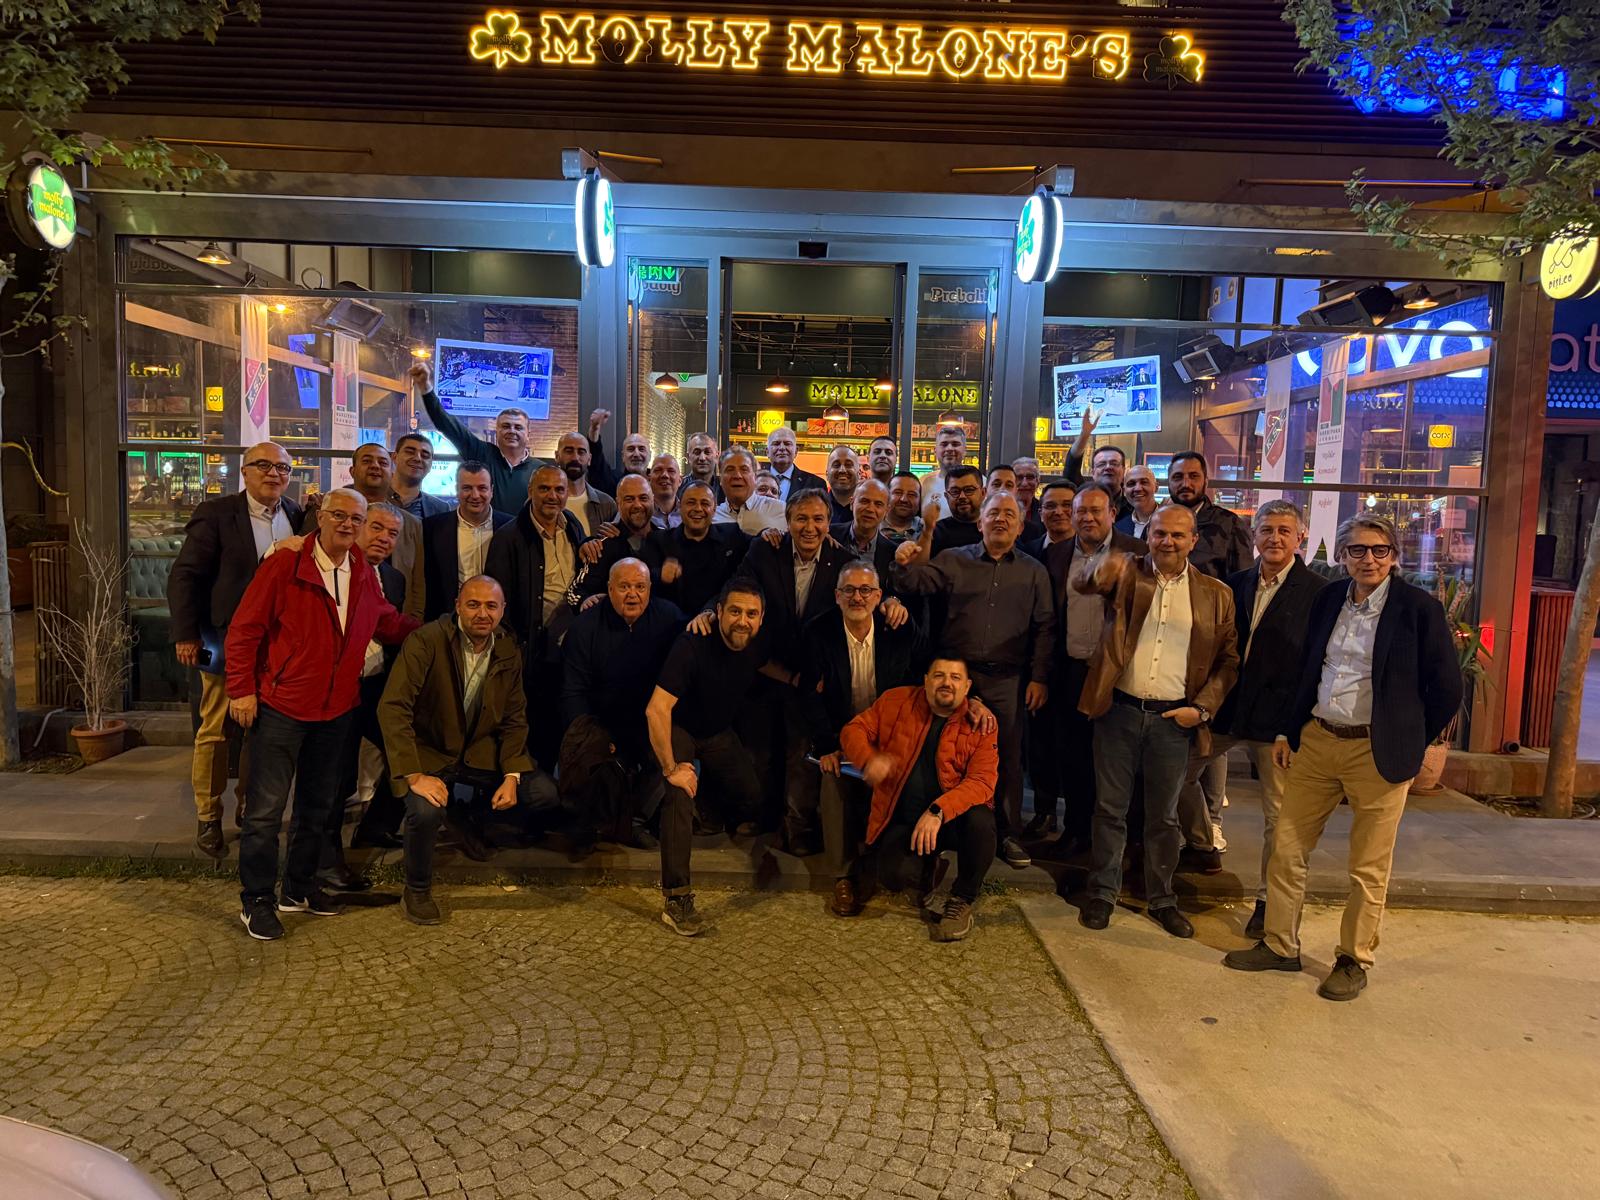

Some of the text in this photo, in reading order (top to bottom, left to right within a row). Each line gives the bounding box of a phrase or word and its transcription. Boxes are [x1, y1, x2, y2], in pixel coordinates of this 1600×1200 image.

[541, 15, 1131, 80] MOLLY MALONE'S
[811, 383, 978, 404] MOLLY ALONE
